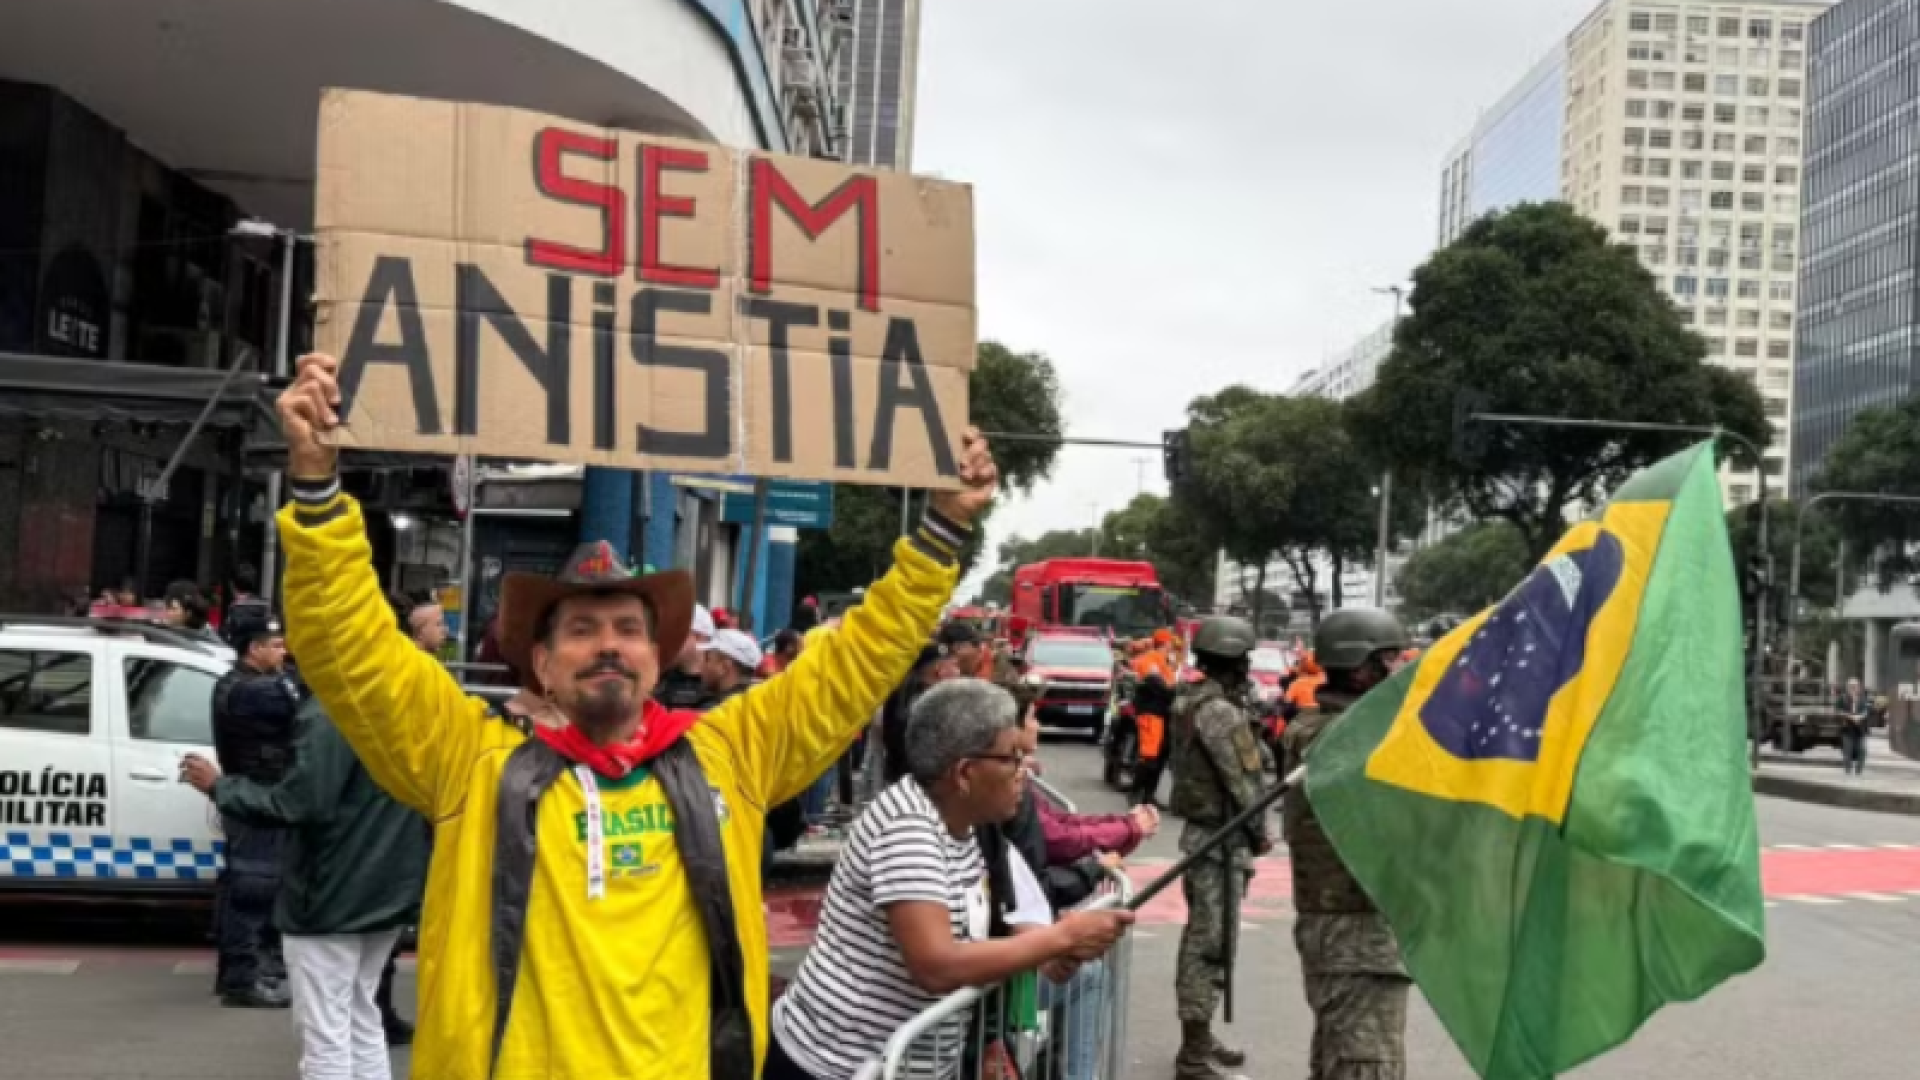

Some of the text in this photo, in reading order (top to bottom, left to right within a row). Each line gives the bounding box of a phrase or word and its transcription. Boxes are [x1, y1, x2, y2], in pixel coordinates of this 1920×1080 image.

[525, 125, 880, 314] SEM
[0, 764, 108, 799] OLÍCIA
[0, 800, 106, 828] ILITAR
[574, 803, 676, 842] BASIL
